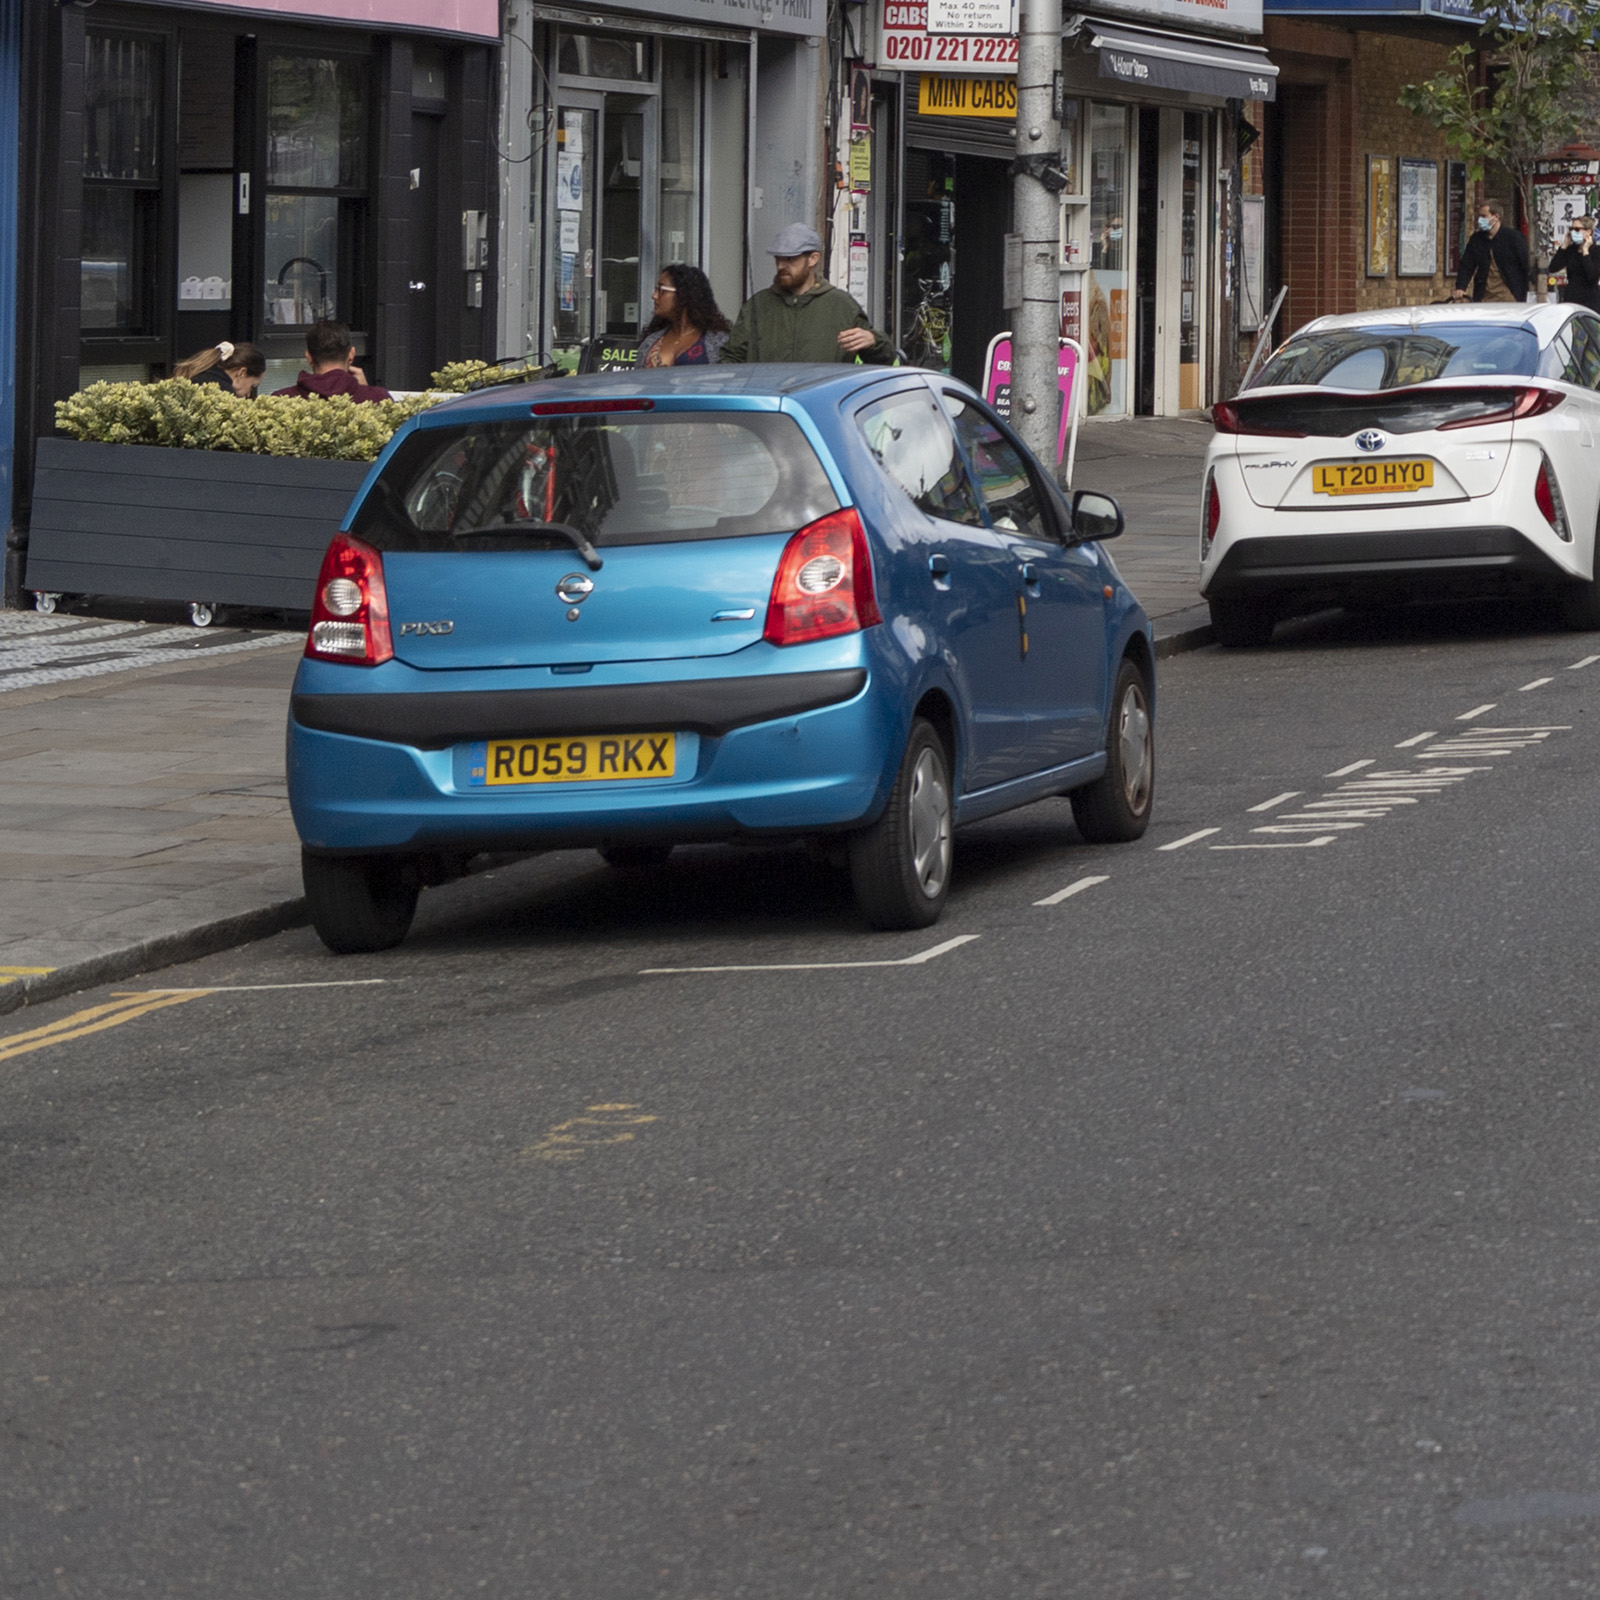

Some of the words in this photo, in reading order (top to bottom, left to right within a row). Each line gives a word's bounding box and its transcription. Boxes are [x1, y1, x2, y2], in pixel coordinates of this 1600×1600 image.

[886, 5, 927, 25] CABS
[939, 2, 958, 11] Max
[962, 2, 975, 11] 40
[979, 2, 1001, 11] mins
[935, 20, 965, 29] Within
[968, 21, 974, 29] 2
[977, 20, 1003, 29] hours
[947, 12, 961, 20] No
[964, 12, 992, 20] return
[886, 36, 933, 61] 0207
[936, 37, 969, 62] 221
[972, 38, 1019, 63] 2222
[928, 77, 966, 108] MINI
[971, 79, 1017, 110] CABS
[601, 348, 638, 363] SALE
[1322, 466, 1377, 488] LT20
[1384, 463, 1425, 485] HYO
[400, 620, 454, 637] PIXO
[494, 741, 587, 778] RO59
[599, 738, 668, 773] RKX
